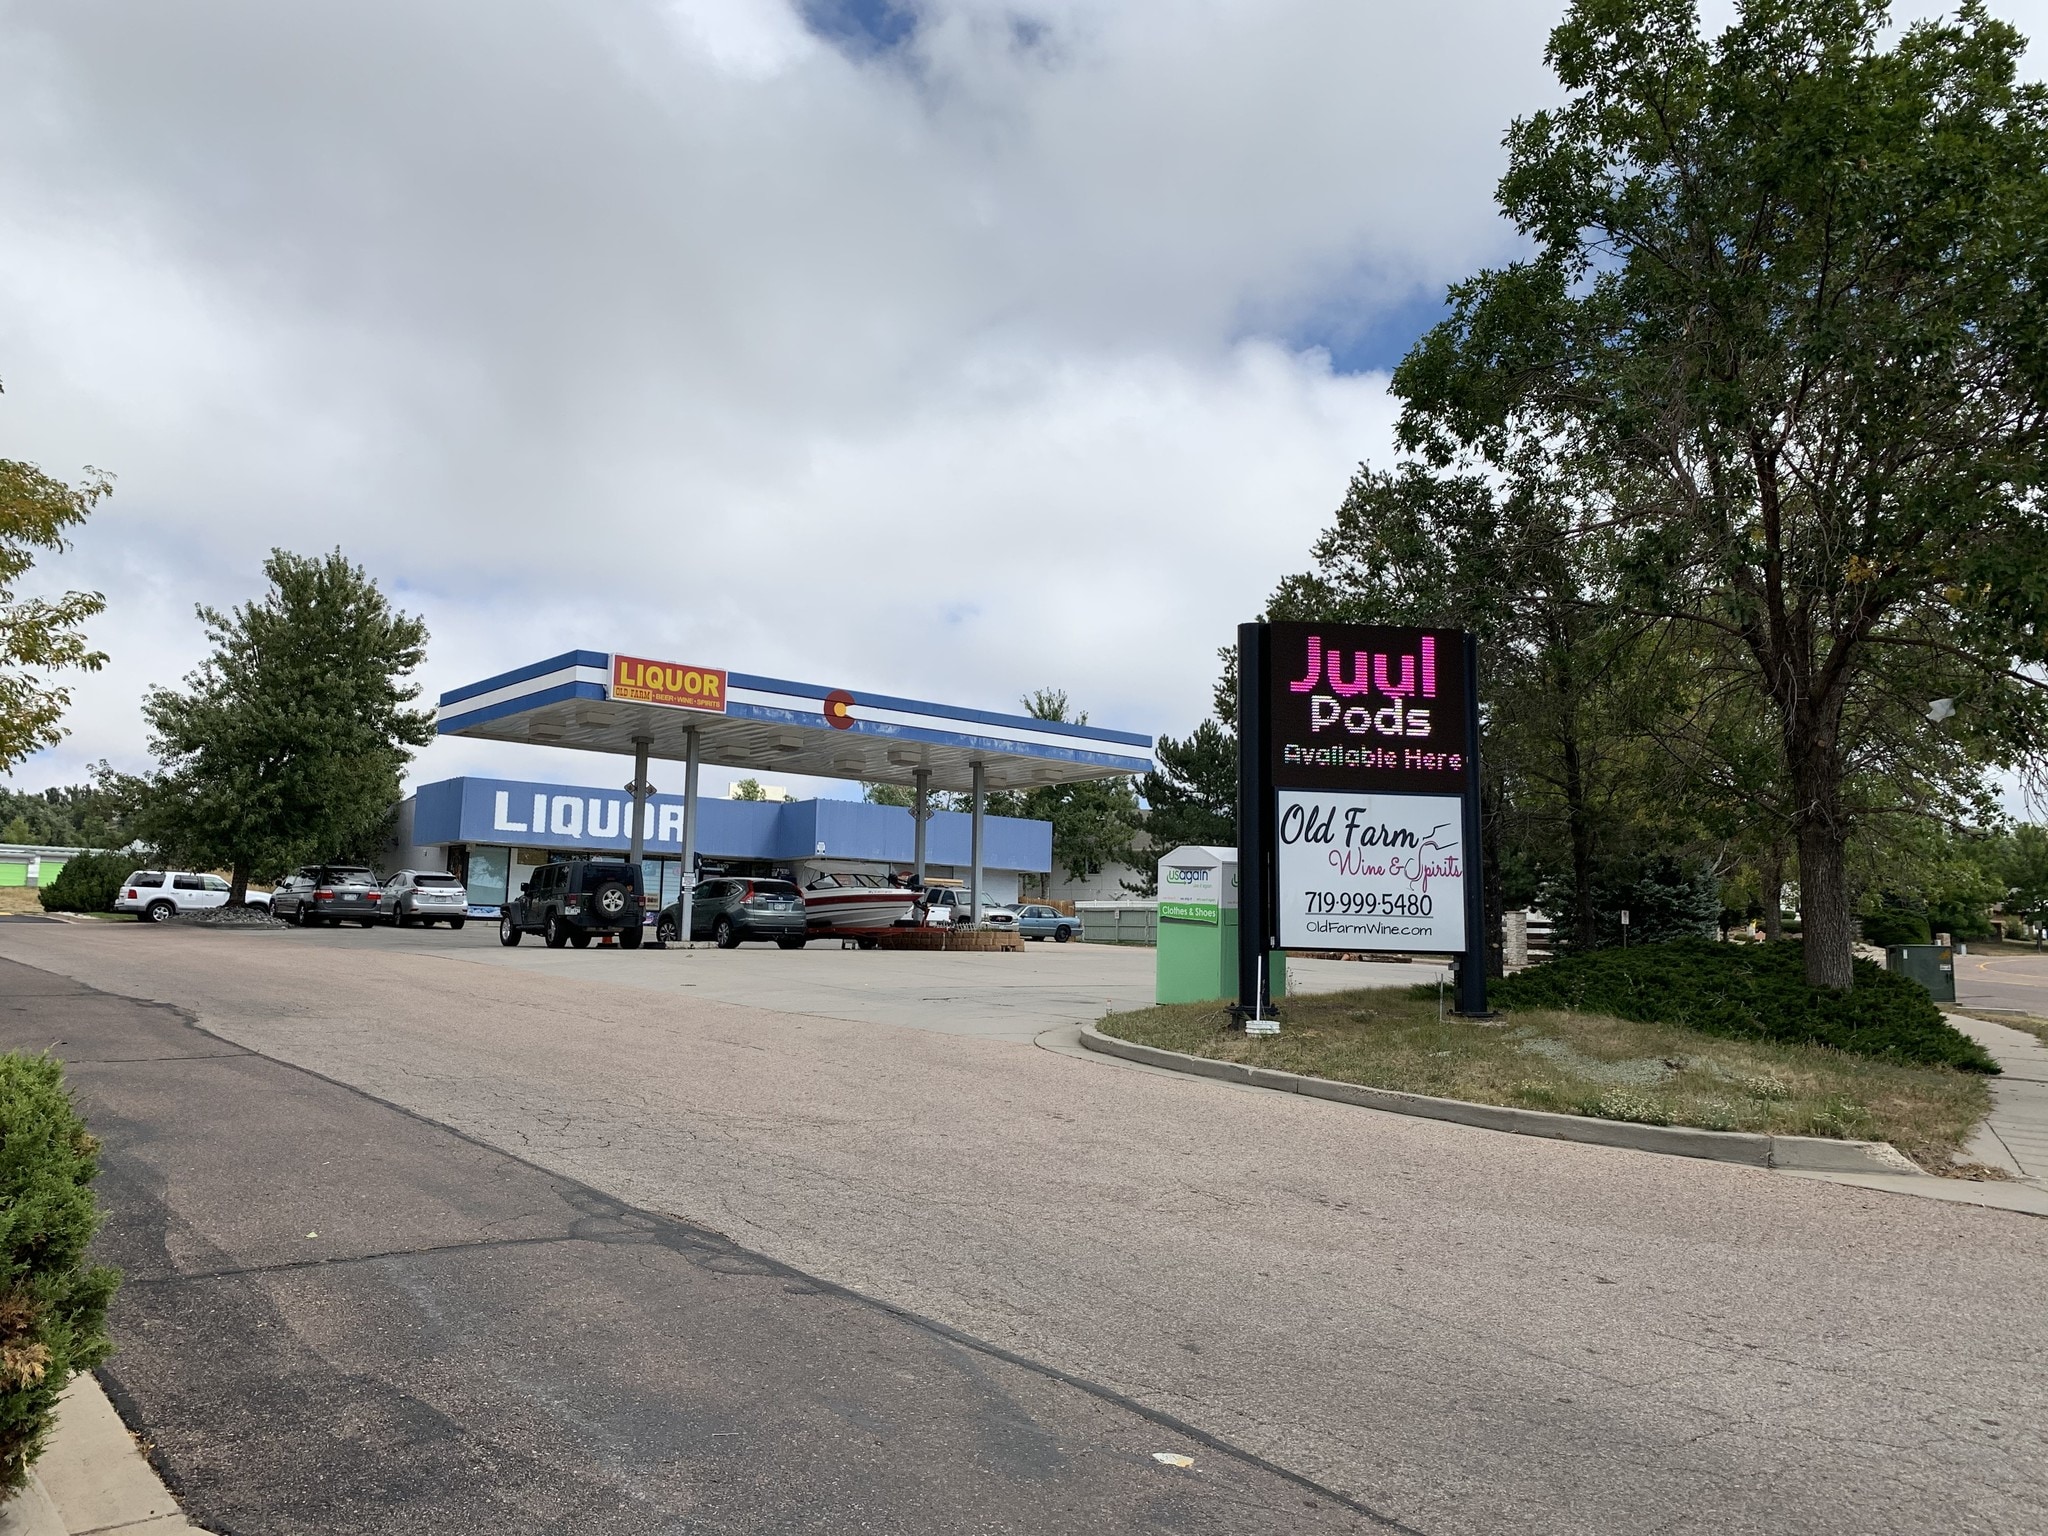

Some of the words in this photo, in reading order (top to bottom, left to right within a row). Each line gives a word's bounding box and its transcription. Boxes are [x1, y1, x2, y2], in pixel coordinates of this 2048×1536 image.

[620, 662, 719, 698] LIQUOR
[1289, 635, 1436, 699] Juul
[615, 686, 629, 697] OLD
[630, 688, 651, 700] FARM
[655, 694, 674, 702] BEER
[677, 696, 694, 705] WINE
[697, 699, 721, 708] SPIRITS
[1311, 694, 1433, 737] Pods
[1284, 742, 1398, 769] Available
[1404, 748, 1462, 771] Here
[494, 791, 684, 842] LIQUOR
[1280, 803, 1337, 845] Old
[1344, 807, 1420, 849] Farm
[1328, 846, 1386, 876] Wine
[1389, 856, 1405, 876] &
[1404, 841, 1463, 893] Spirits
[1162, 906, 1187, 916] Clothes
[1188, 908, 1194, 916] &
[1195, 908, 1216, 917] Shoes
[1306, 920, 1433, 936] OldFarmWine.com
